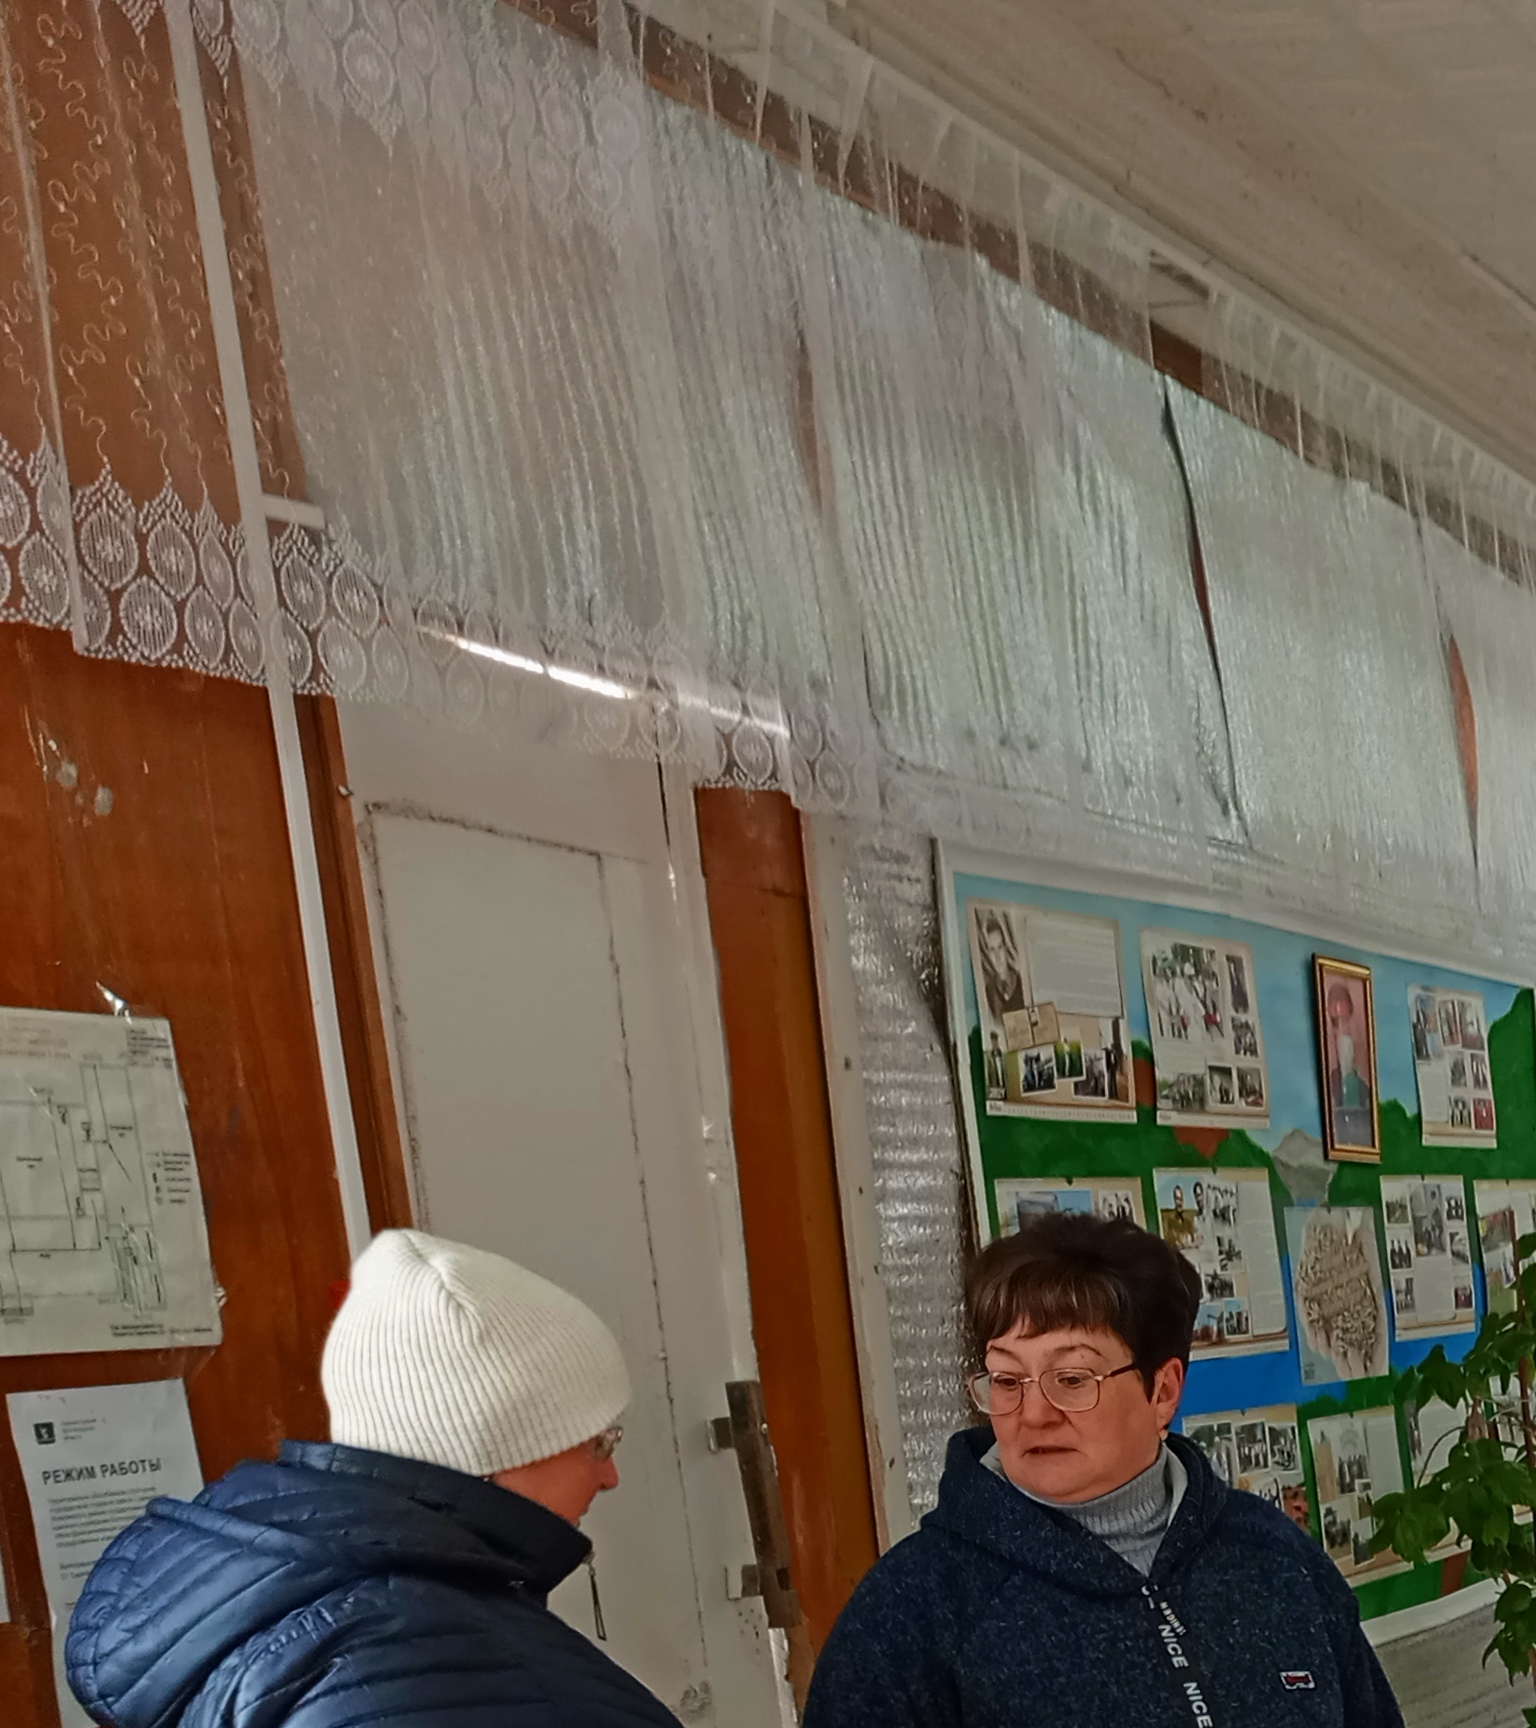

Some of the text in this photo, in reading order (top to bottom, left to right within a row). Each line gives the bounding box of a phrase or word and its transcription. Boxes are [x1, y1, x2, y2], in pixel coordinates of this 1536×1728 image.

[41, 1457, 162, 1486] РЕЖИМ РАБОТЫ
[1158, 1624, 1189, 1668] NICE
[1183, 1682, 1213, 1728] NICE
